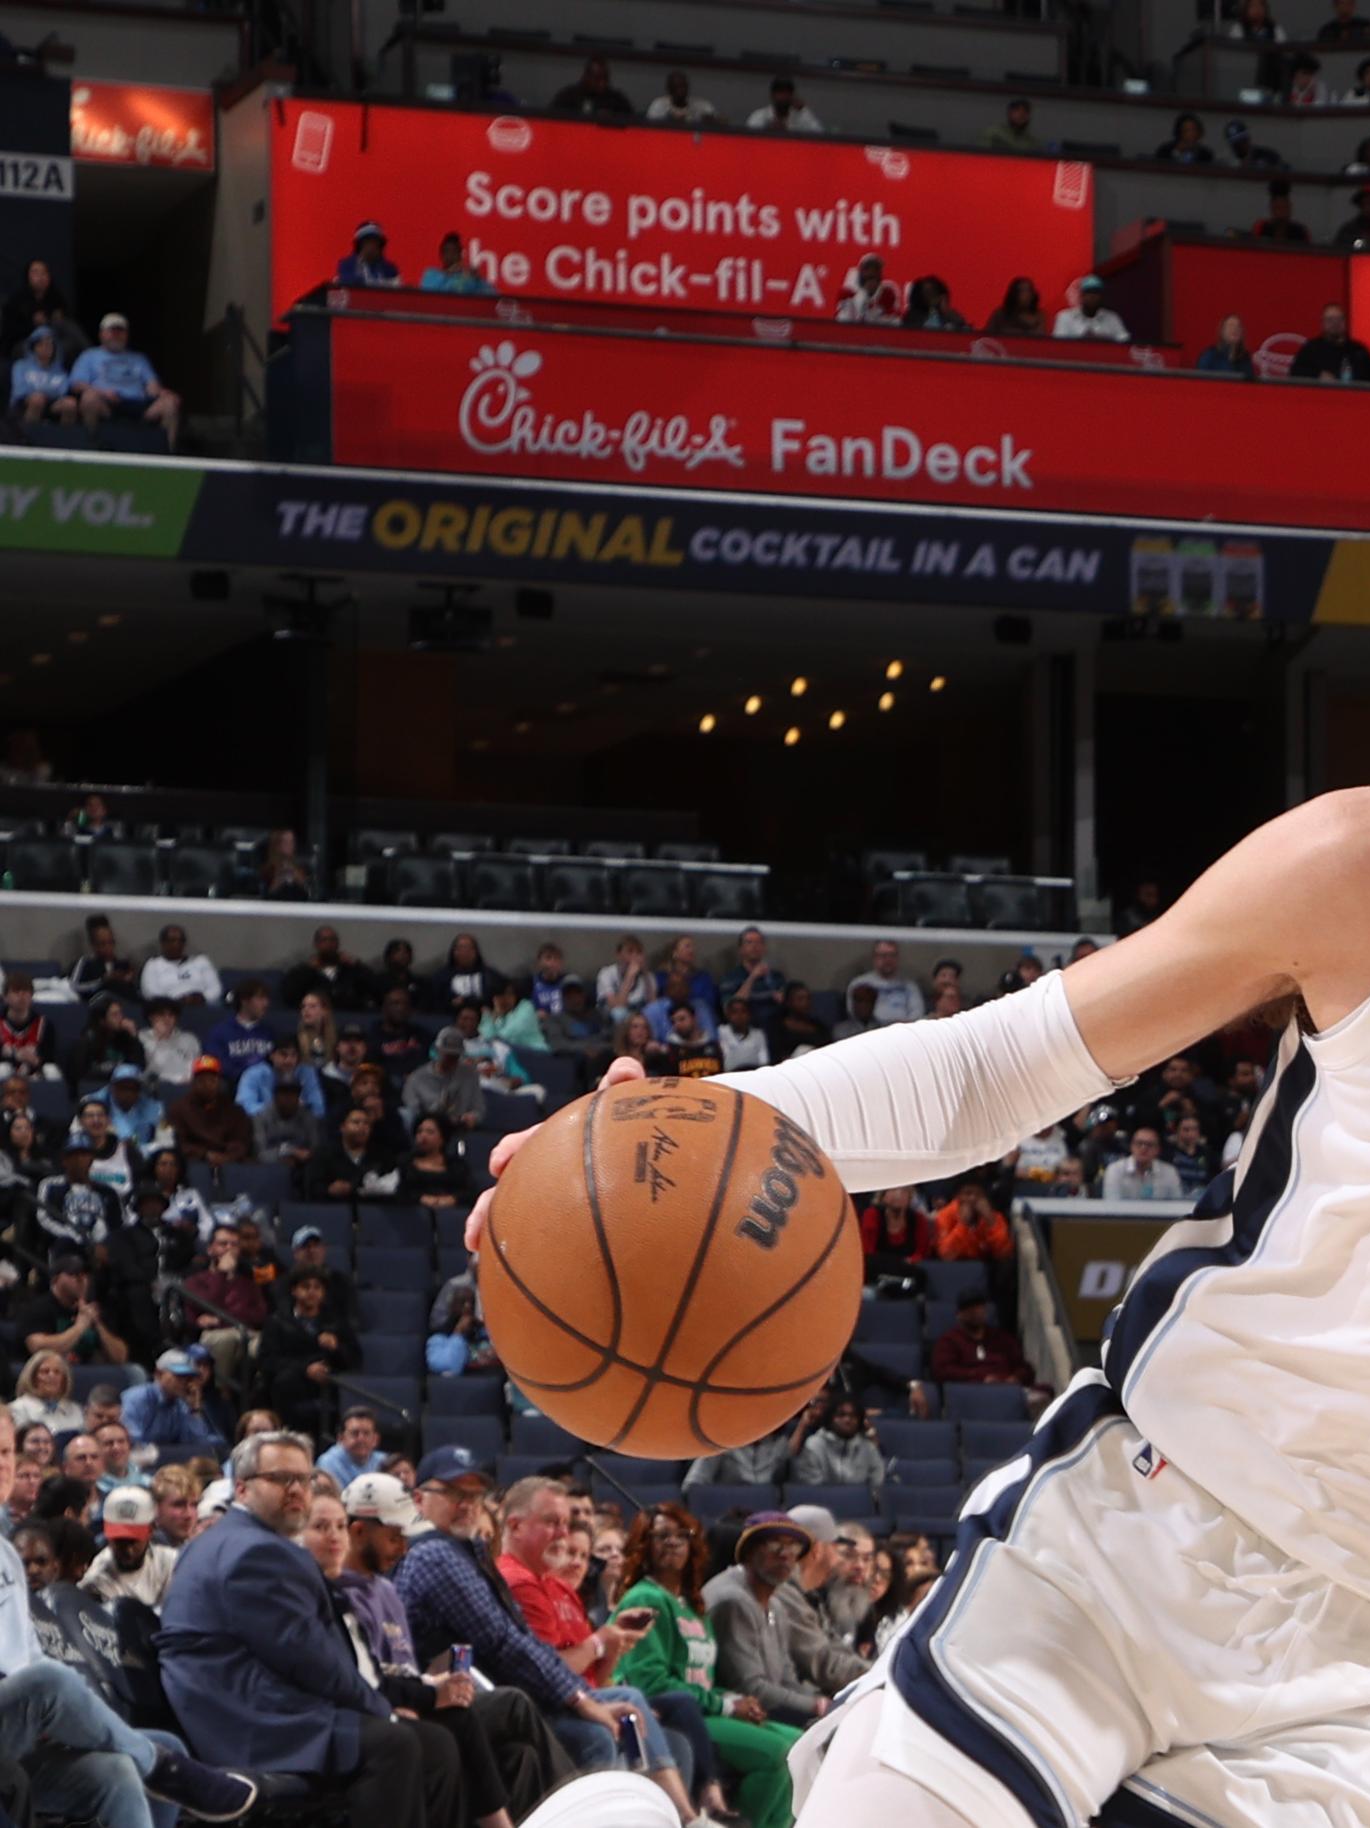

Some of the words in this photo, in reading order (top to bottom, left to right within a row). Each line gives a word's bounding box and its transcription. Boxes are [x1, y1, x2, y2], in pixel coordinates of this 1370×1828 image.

[465, 171, 612, 225] Score
[627, 188, 781, 240] points
[795, 199, 901, 248] with
[463, 238, 531, 287] he
[458, 364, 745, 472] Chick-fil-A
[771, 417, 1033, 489] FanDeck
[277, 500, 368, 541] THE
[372, 500, 685, 567] ORIGINAL
[690, 527, 901, 574] COCKTAIL
[911, 534, 958, 578] IN
[963, 539, 998, 580] A
[1007, 541, 1101, 584] CAN
[1078, 1261, 1137, 1298] D
